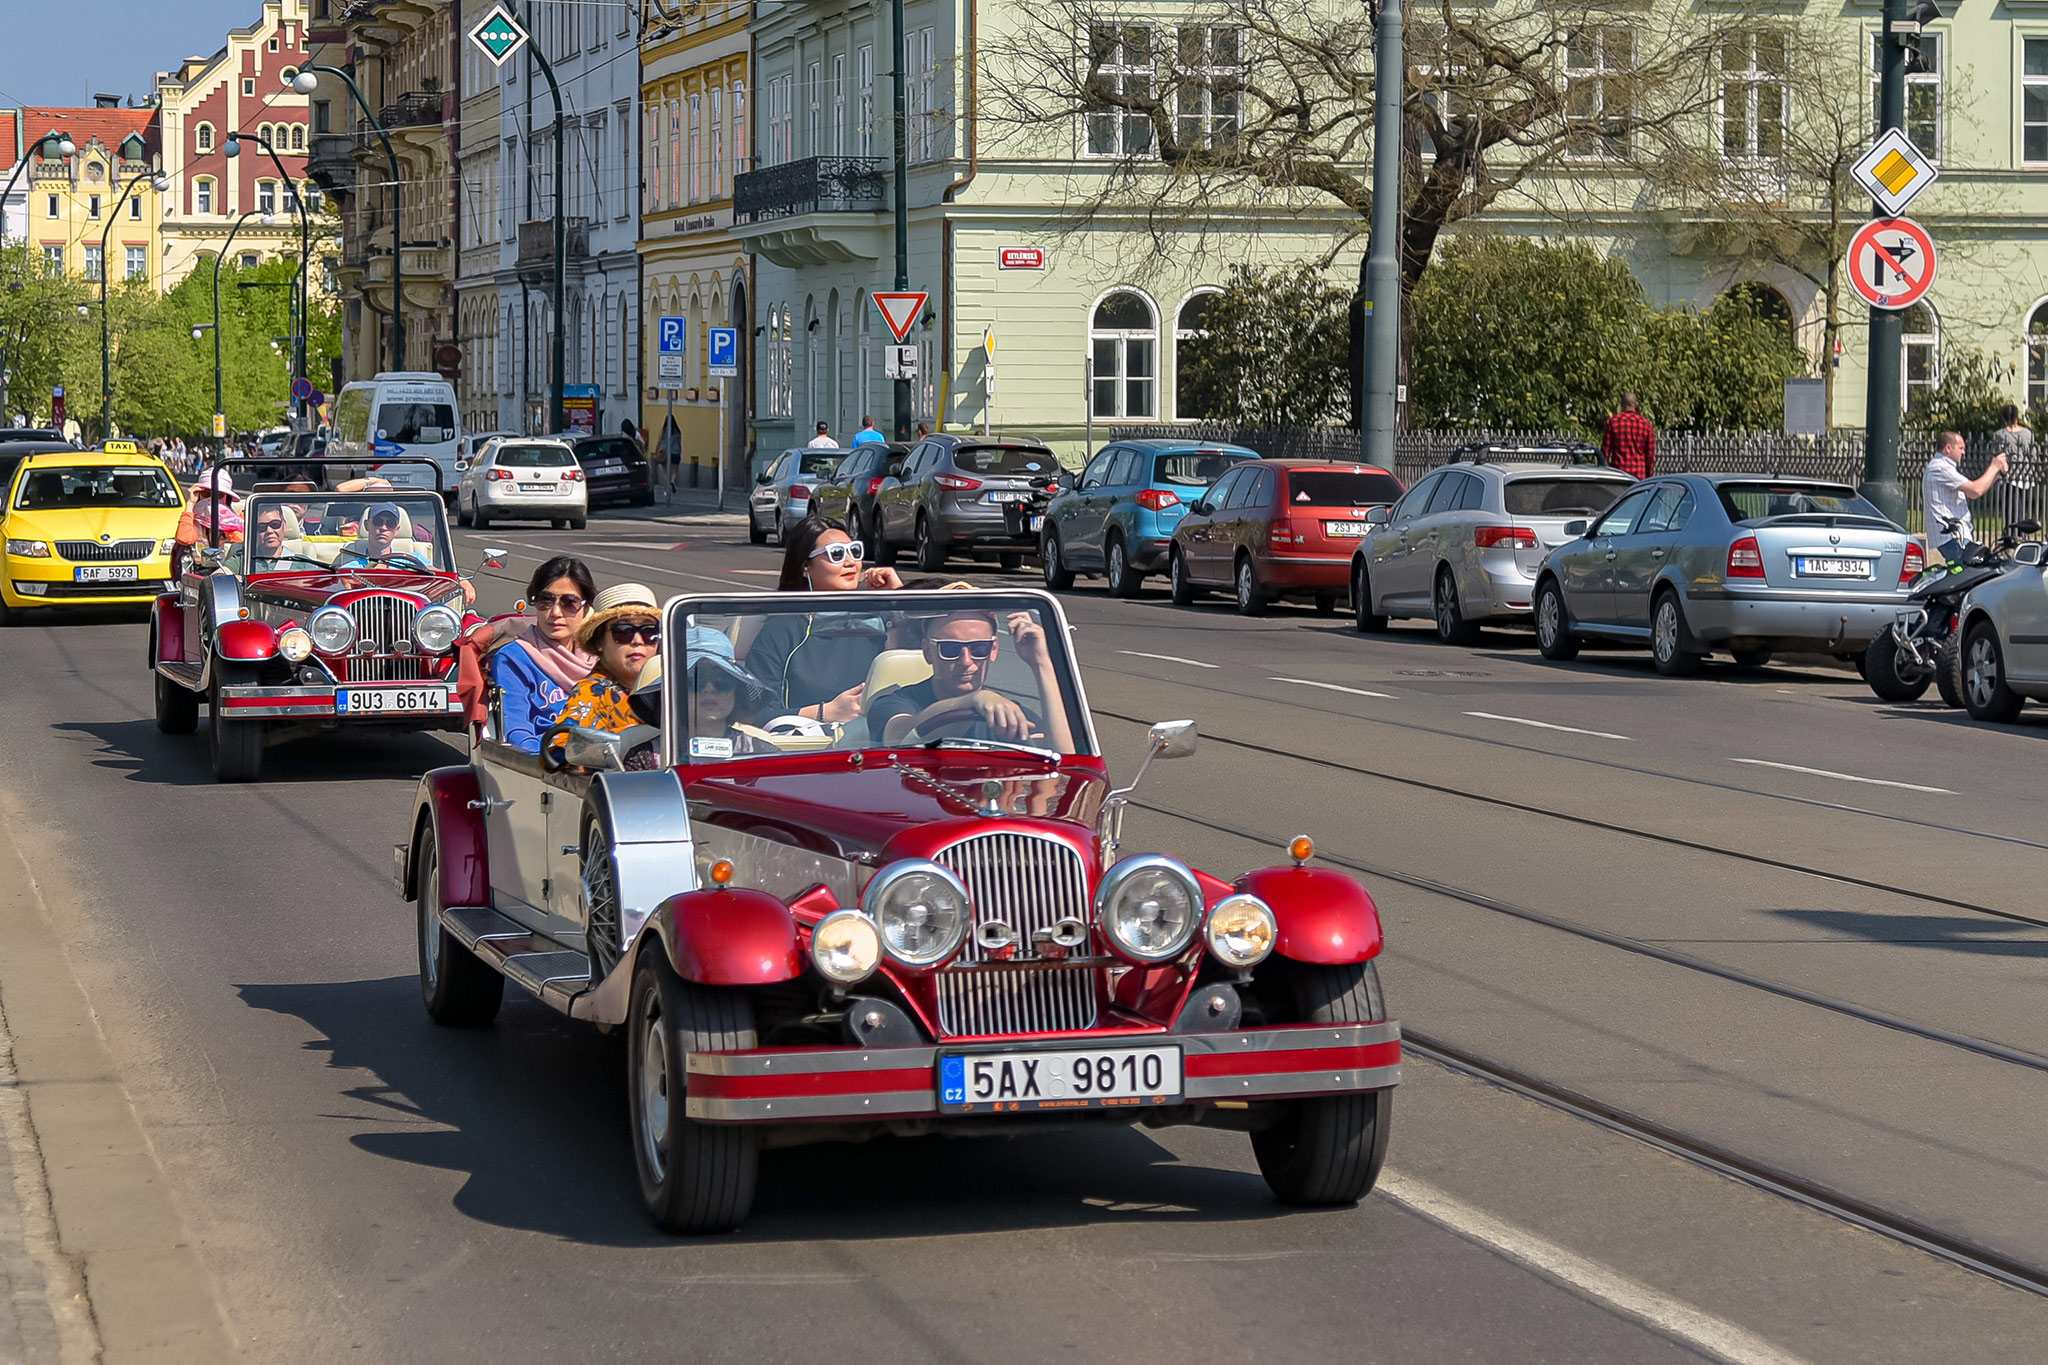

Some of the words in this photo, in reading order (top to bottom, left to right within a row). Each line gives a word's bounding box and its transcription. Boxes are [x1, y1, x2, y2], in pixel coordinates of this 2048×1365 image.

[664, 321, 679, 342] P
[714, 332, 731, 355] P
[442, 428, 454, 439] 17
[1334, 523, 1351, 533] 2S3
[82, 568, 101, 579] 5AF
[108, 567, 133, 578] 5929
[1808, 559, 1829, 571] 1AC
[1837, 560, 1864, 573] 3934
[351, 692, 383, 710] 9U3
[396, 691, 439, 709] 6614
[945, 1088, 963, 1101] CZ
[973, 1059, 1041, 1099] 5AX
[1072, 1053, 1162, 1095] 9810
